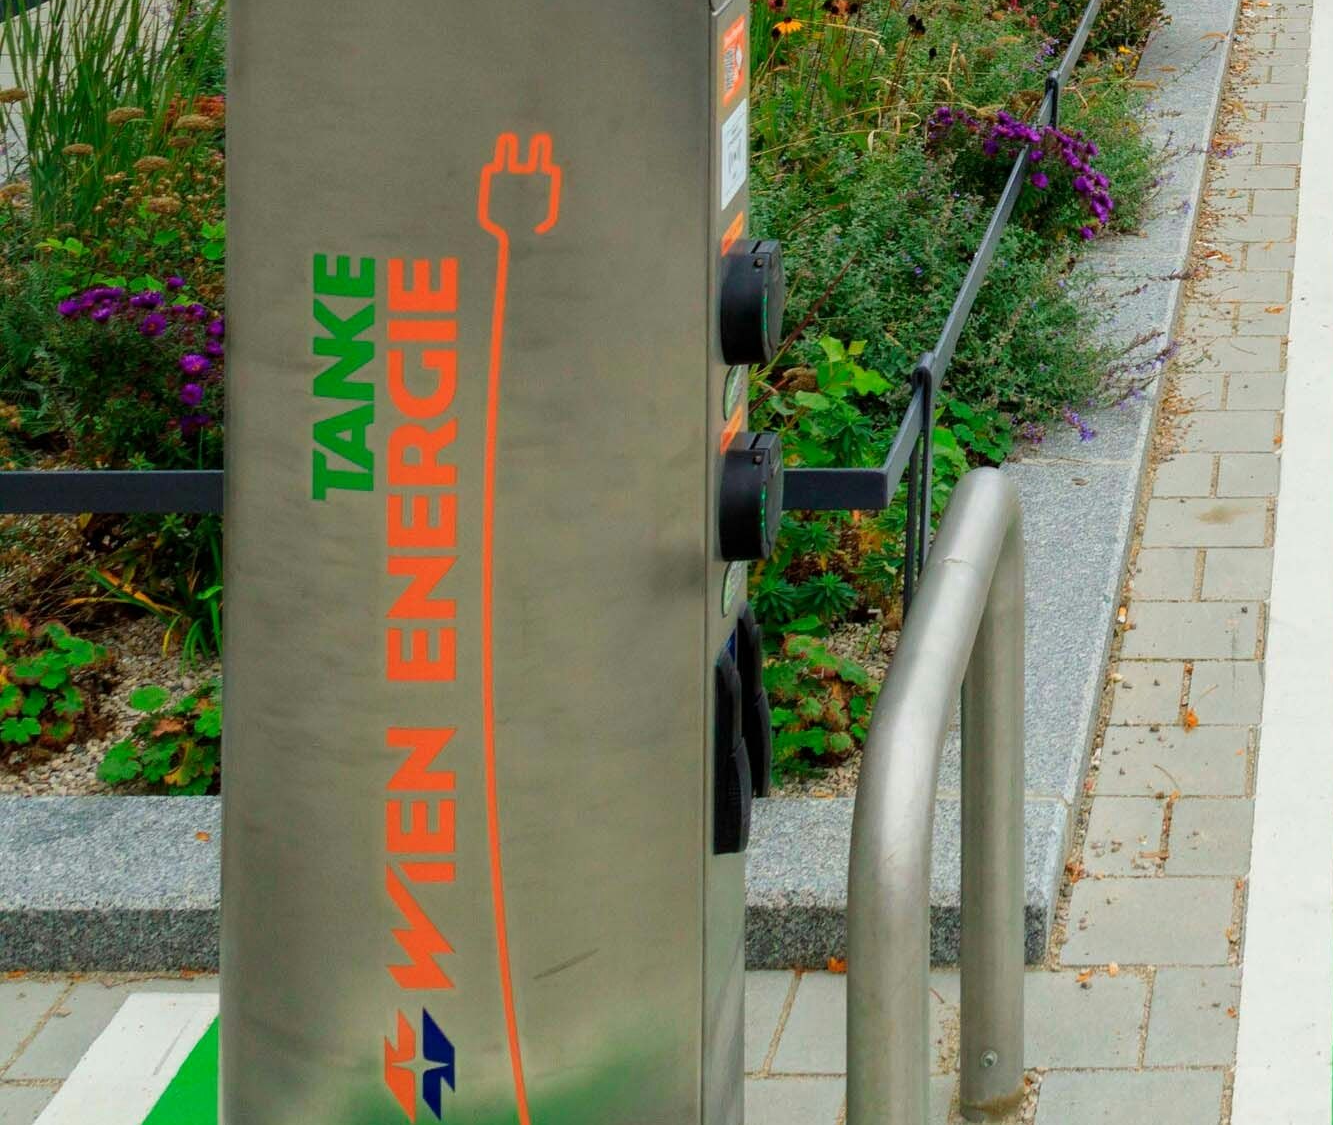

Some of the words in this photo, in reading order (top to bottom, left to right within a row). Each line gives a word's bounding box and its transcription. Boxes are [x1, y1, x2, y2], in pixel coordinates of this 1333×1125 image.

[311, 252, 377, 502] TANKE
[387, 257, 458, 682] ENERGIE
[386, 728, 457, 990] WIEN
